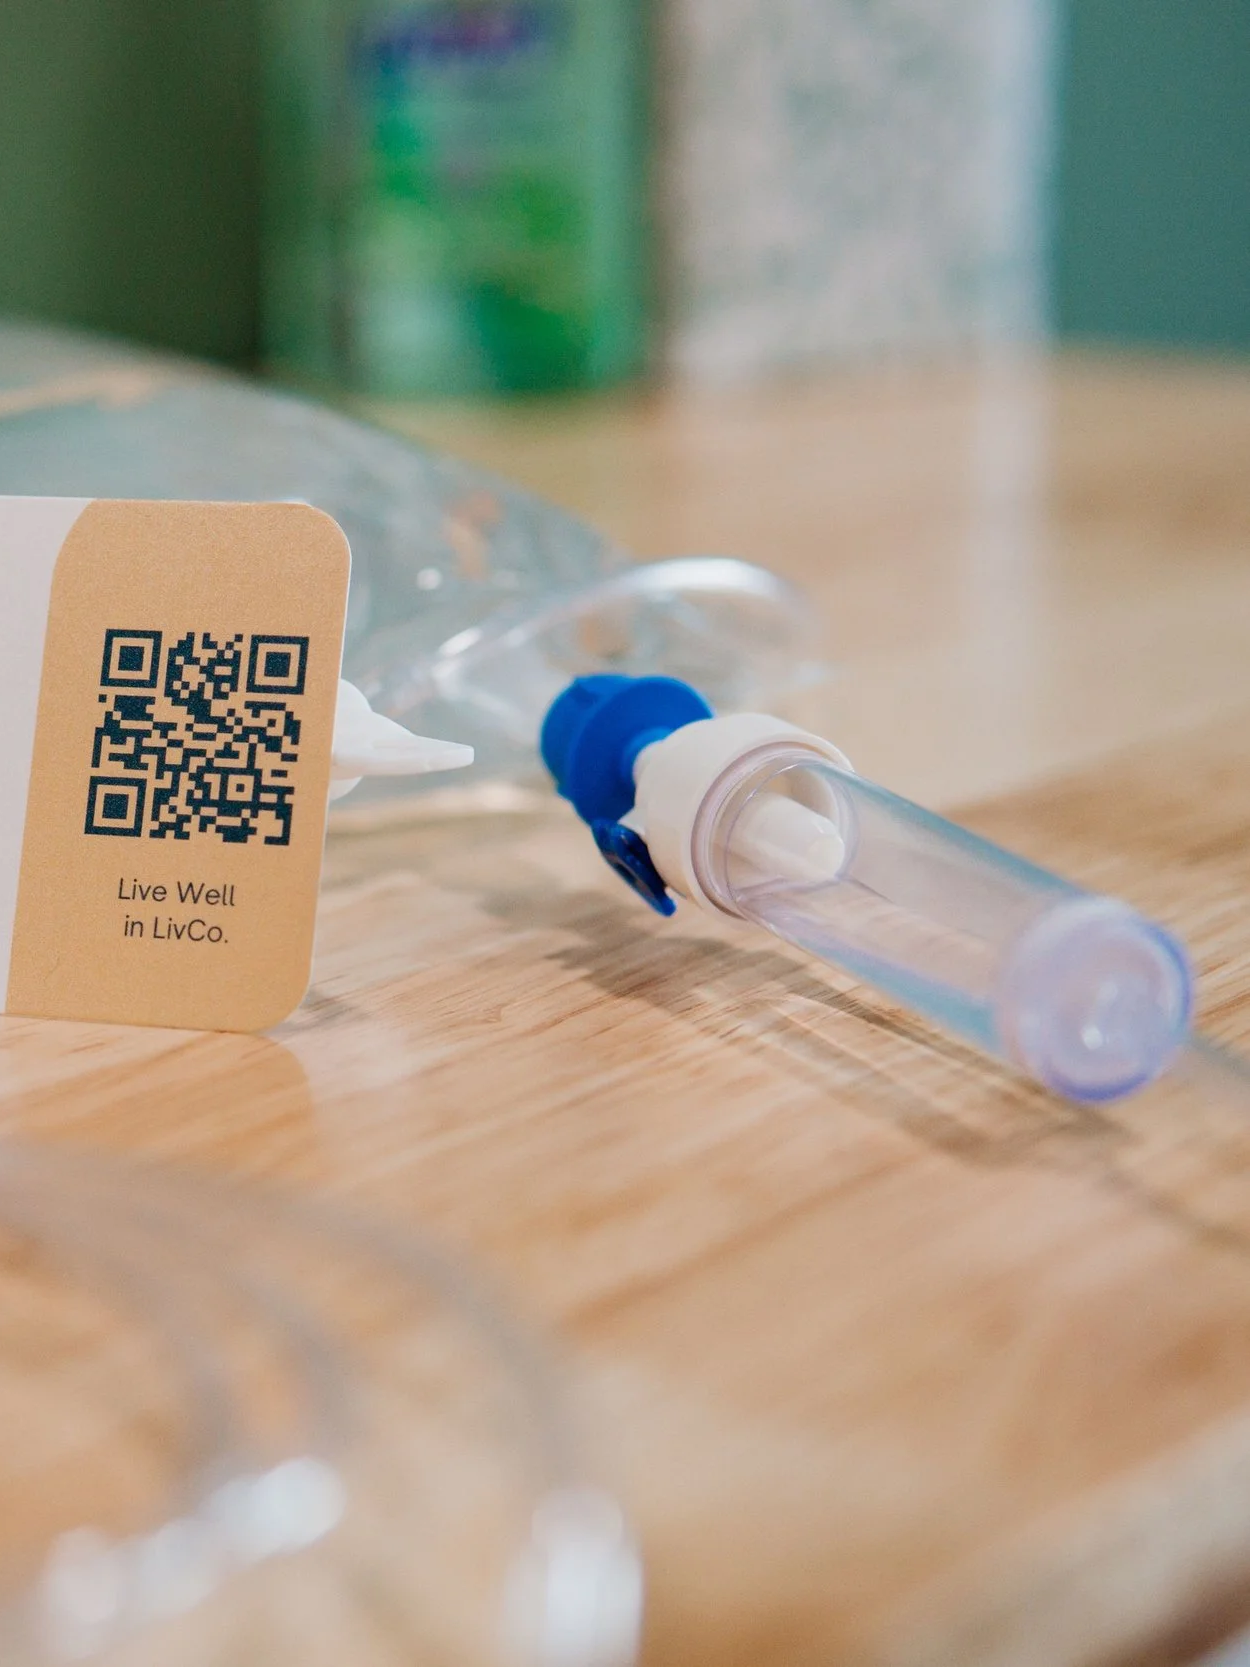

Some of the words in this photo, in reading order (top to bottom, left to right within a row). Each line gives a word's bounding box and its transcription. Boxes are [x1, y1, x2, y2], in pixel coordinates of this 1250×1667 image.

[118, 877, 168, 903] Live
[177, 880, 236, 907] Well
[124, 914, 145, 938] in
[153, 915, 229, 944] LivCo.
